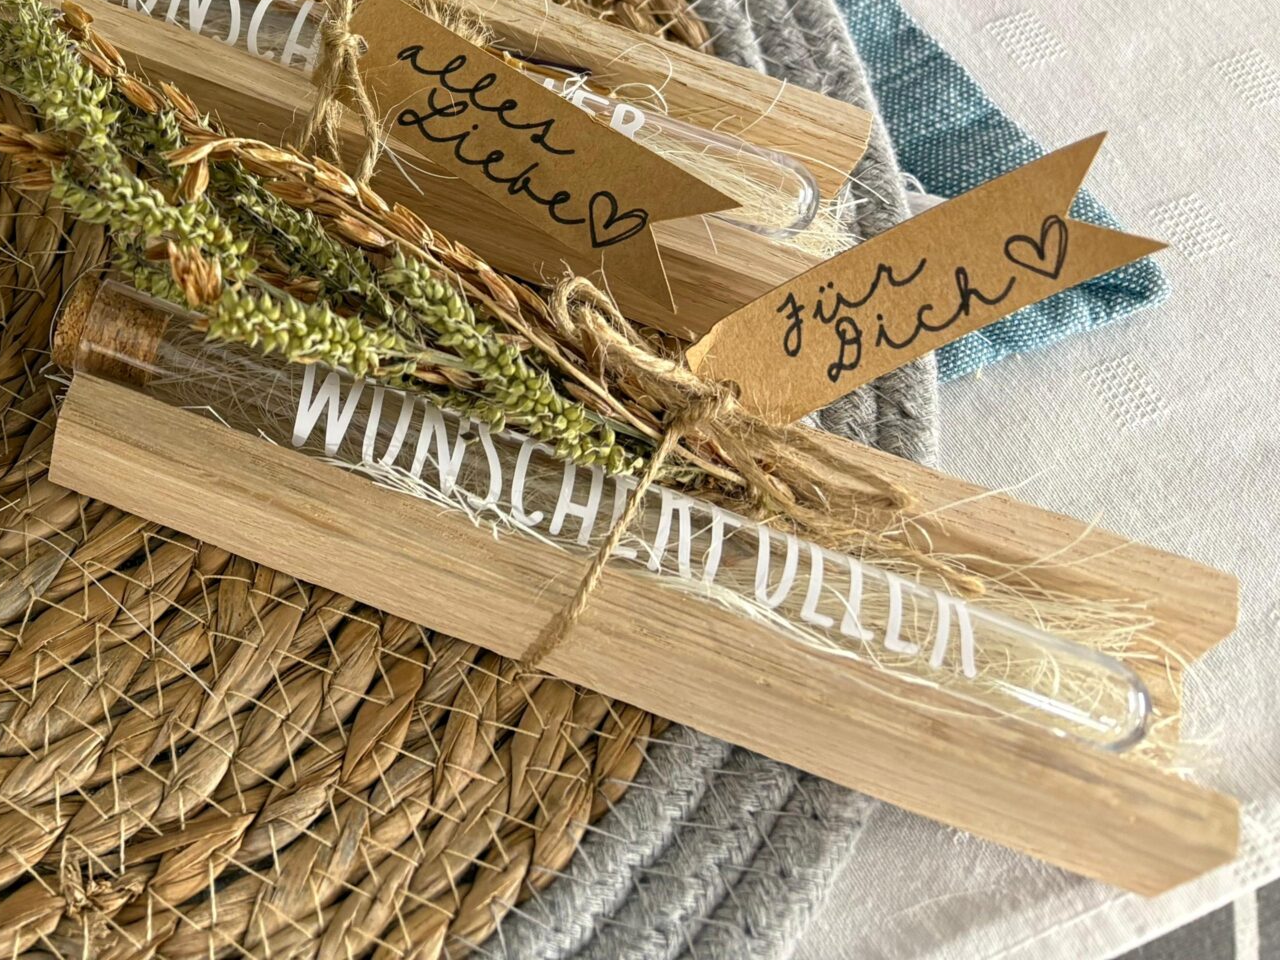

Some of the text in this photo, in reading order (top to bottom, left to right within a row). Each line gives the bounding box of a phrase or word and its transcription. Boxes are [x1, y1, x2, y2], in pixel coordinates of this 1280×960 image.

[397, 45, 575, 155] alles
[397, 87, 586, 225] Liebe
[776, 258, 927, 357] Für
[827, 267, 1016, 383] Dich
